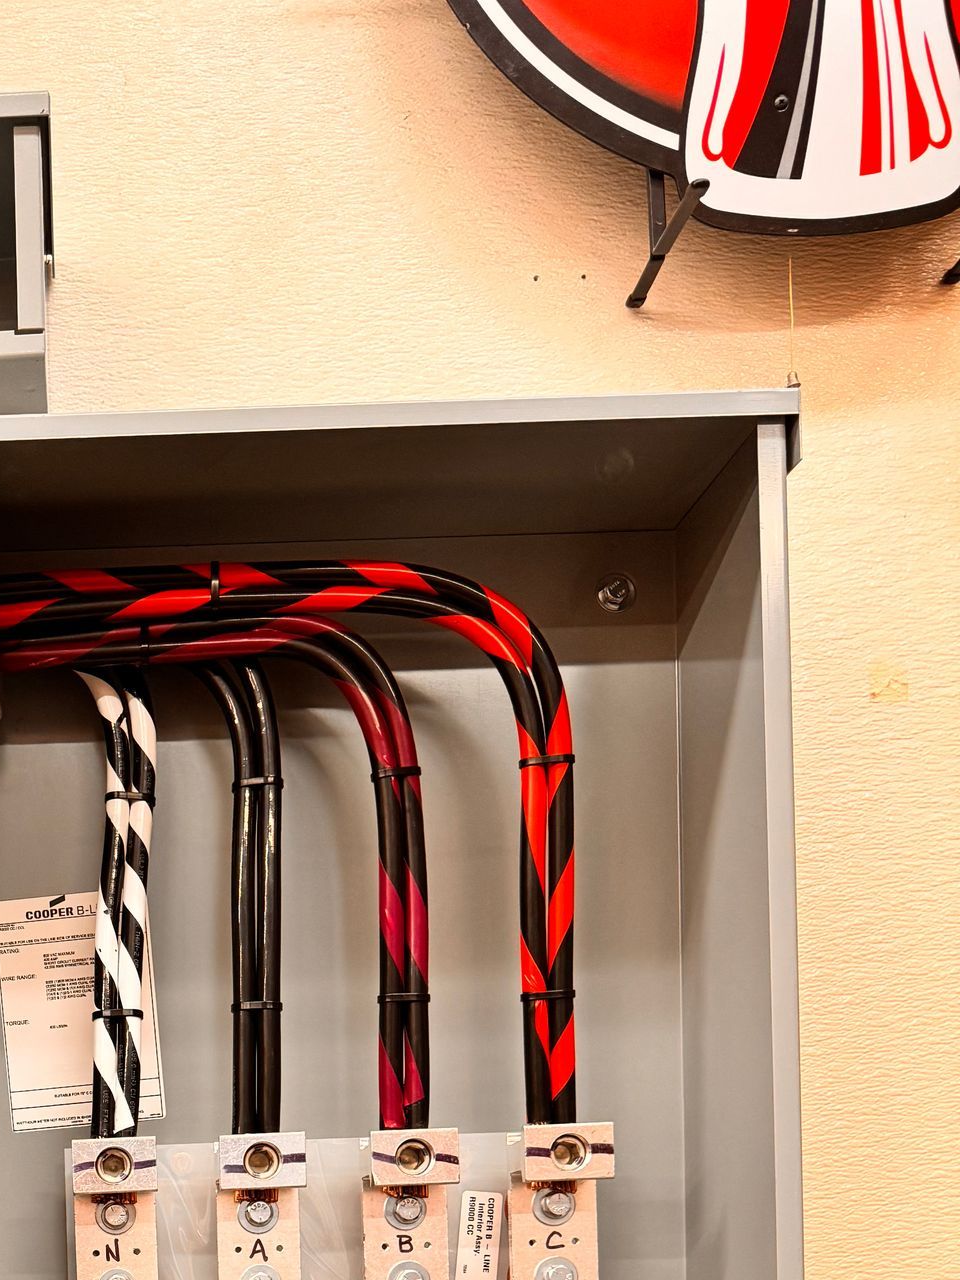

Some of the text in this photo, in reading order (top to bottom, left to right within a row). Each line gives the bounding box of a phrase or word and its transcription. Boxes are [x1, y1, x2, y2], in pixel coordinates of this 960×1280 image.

[25, 906, 74, 920] COOPER
[466, 1196, 476, 1235] R9000 CC
[487, 1197, 495, 1231] COOPER
[474, 1203, 485, 1256] Interior Assy.
[546, 1231, 565, 1249] C
[105, 1238, 120, 1262] N
[249, 1238, 269, 1262] A
[396, 1234, 414, 1253] B
[482, 1254, 491, 1273] LINE
